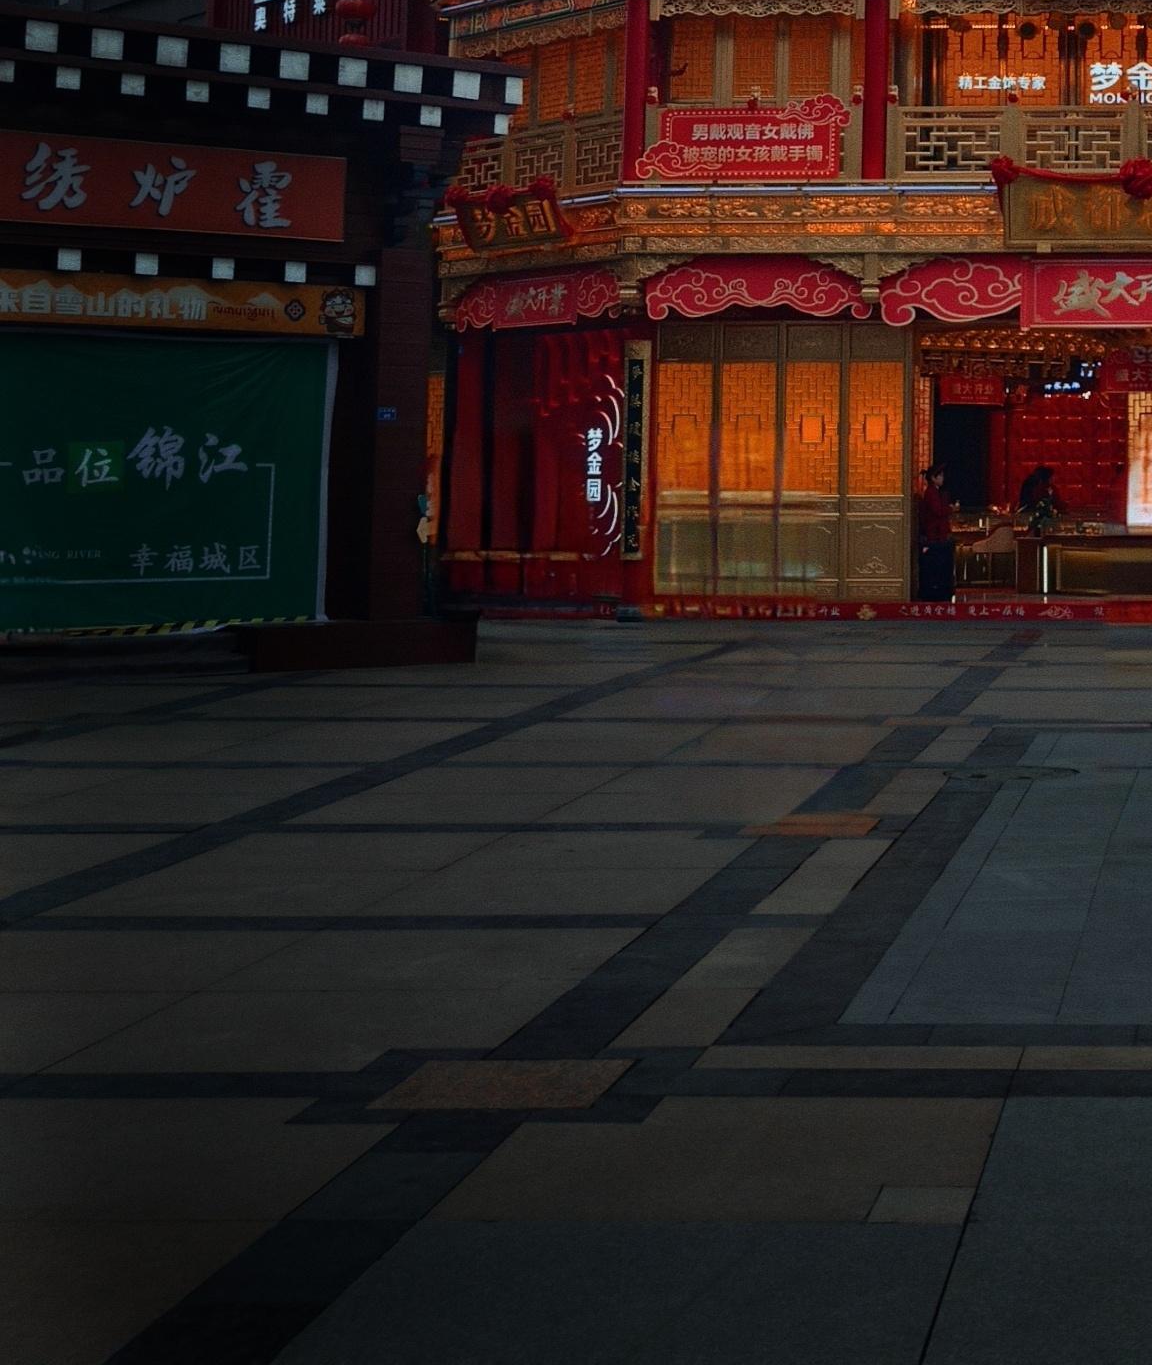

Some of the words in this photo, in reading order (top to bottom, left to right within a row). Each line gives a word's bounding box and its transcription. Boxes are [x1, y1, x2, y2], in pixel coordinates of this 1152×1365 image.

[691, 122, 815, 142] 男戴观音女戴佛
[585, 426, 602, 502] 梦金园
[128, 543, 263, 578] 幸福城区
